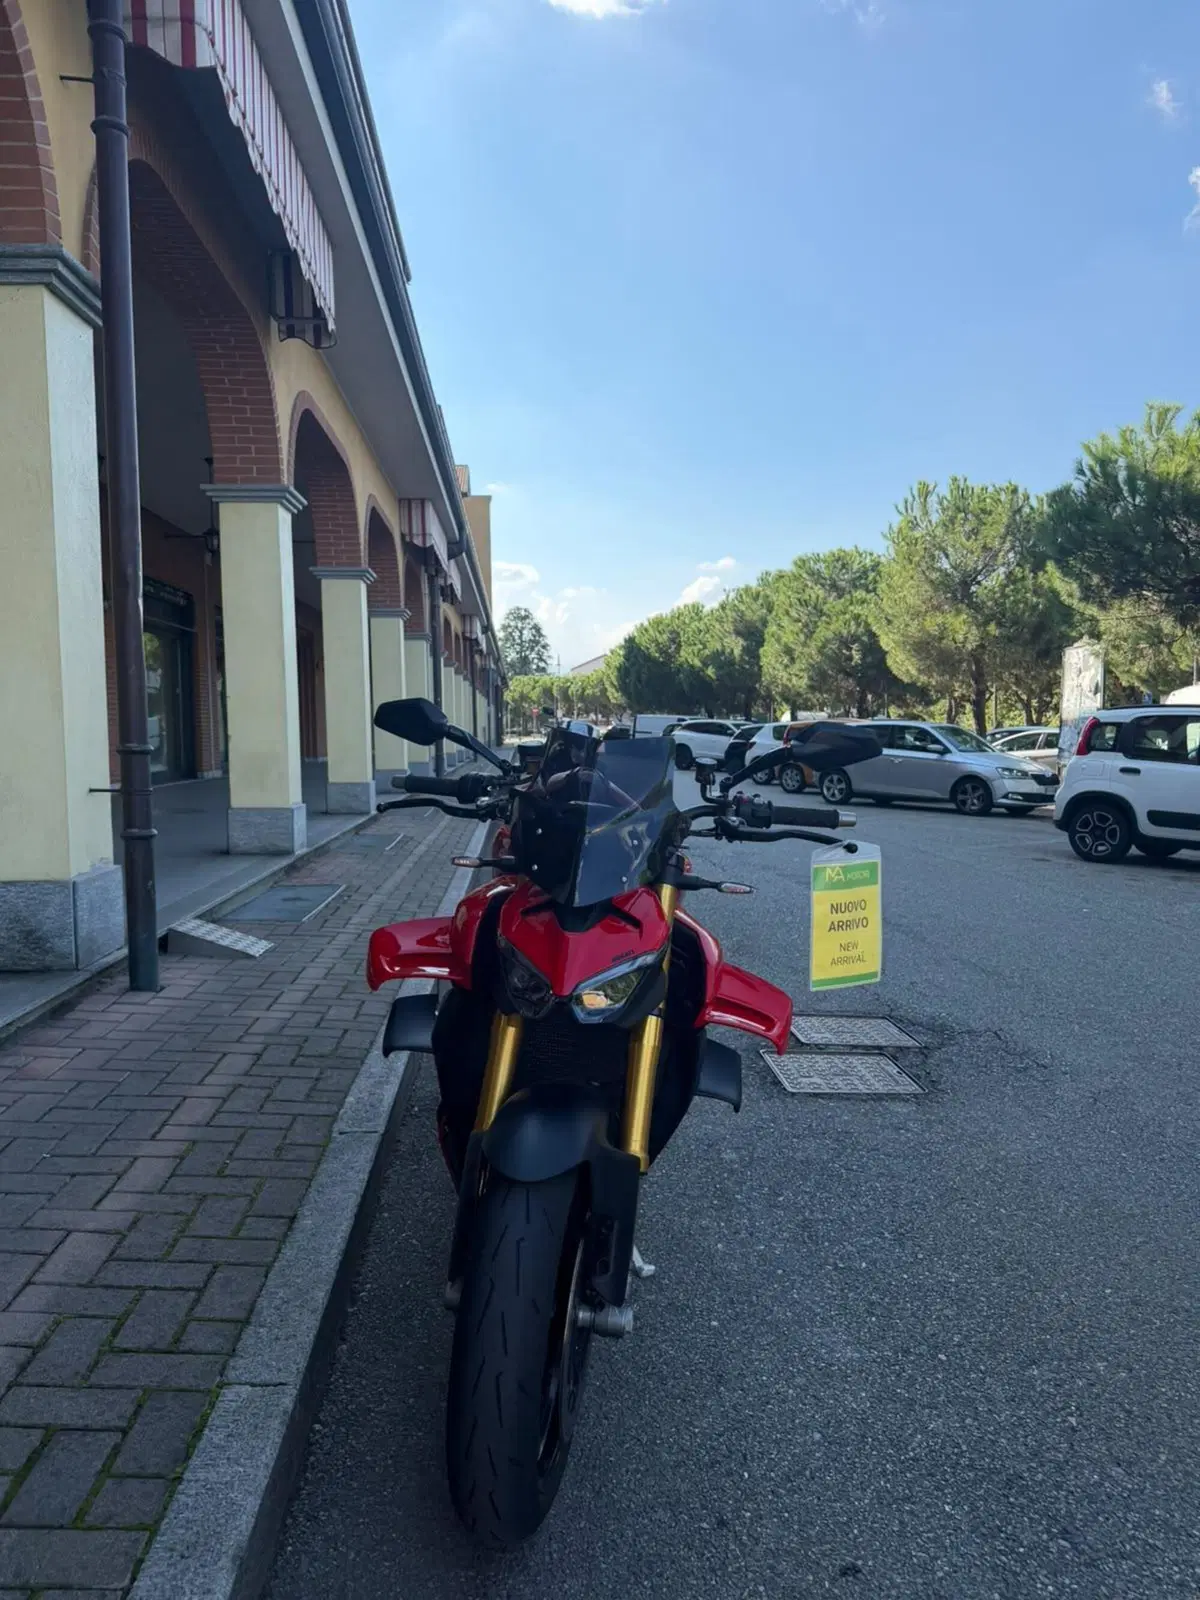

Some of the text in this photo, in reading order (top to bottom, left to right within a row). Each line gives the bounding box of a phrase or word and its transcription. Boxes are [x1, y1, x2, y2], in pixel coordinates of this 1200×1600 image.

[830, 899, 867, 914] NUOVO
[828, 917, 869, 932] ARRIVO
[839, 940, 859, 952] NEW
[830, 953, 867, 966] ARRIVAL
